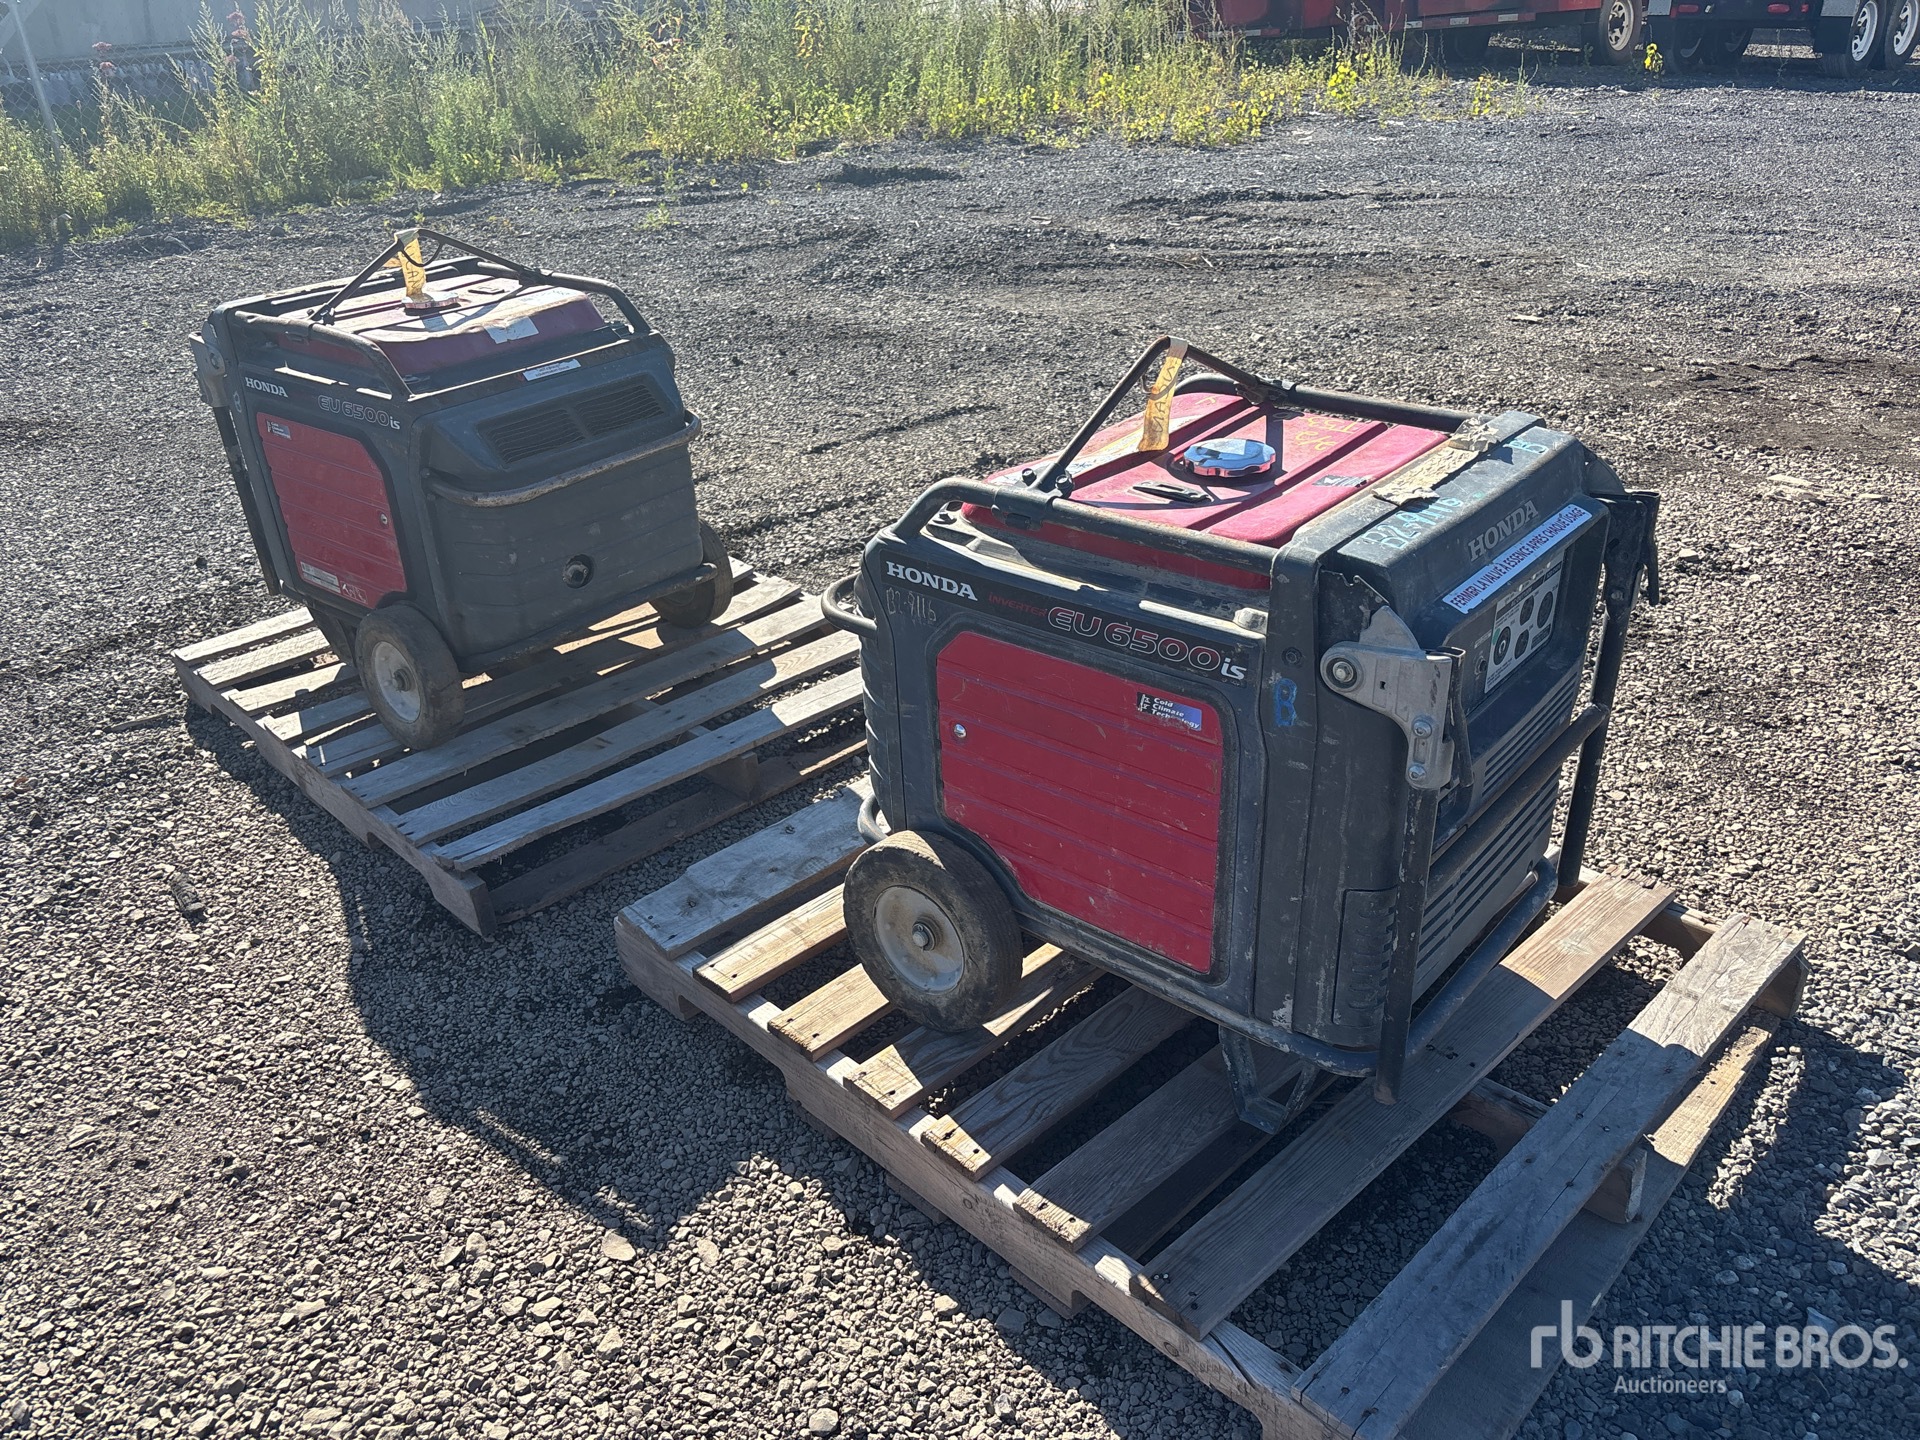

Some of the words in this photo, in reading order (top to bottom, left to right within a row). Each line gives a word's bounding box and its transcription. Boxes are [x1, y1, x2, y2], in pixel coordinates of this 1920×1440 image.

[245, 376, 289, 398] HONDA
[1560, 506, 1585, 523] USAGE
[1467, 499, 1540, 562] HONDA
[1540, 518, 1570, 538] CHAQUE
[1502, 545, 1534, 567] ESSENCE
[886, 561, 978, 601] HONDA
[1472, 578, 1490, 590] LA
[1479, 565, 1507, 584] VALVE
[989, 594, 1047, 616] INVERTER
[1448, 585, 1482, 608] FERMER
[1152, 703, 1185, 717] Climate
[1153, 697, 1174, 707] Cold
[1275, 679, 1297, 726] B
